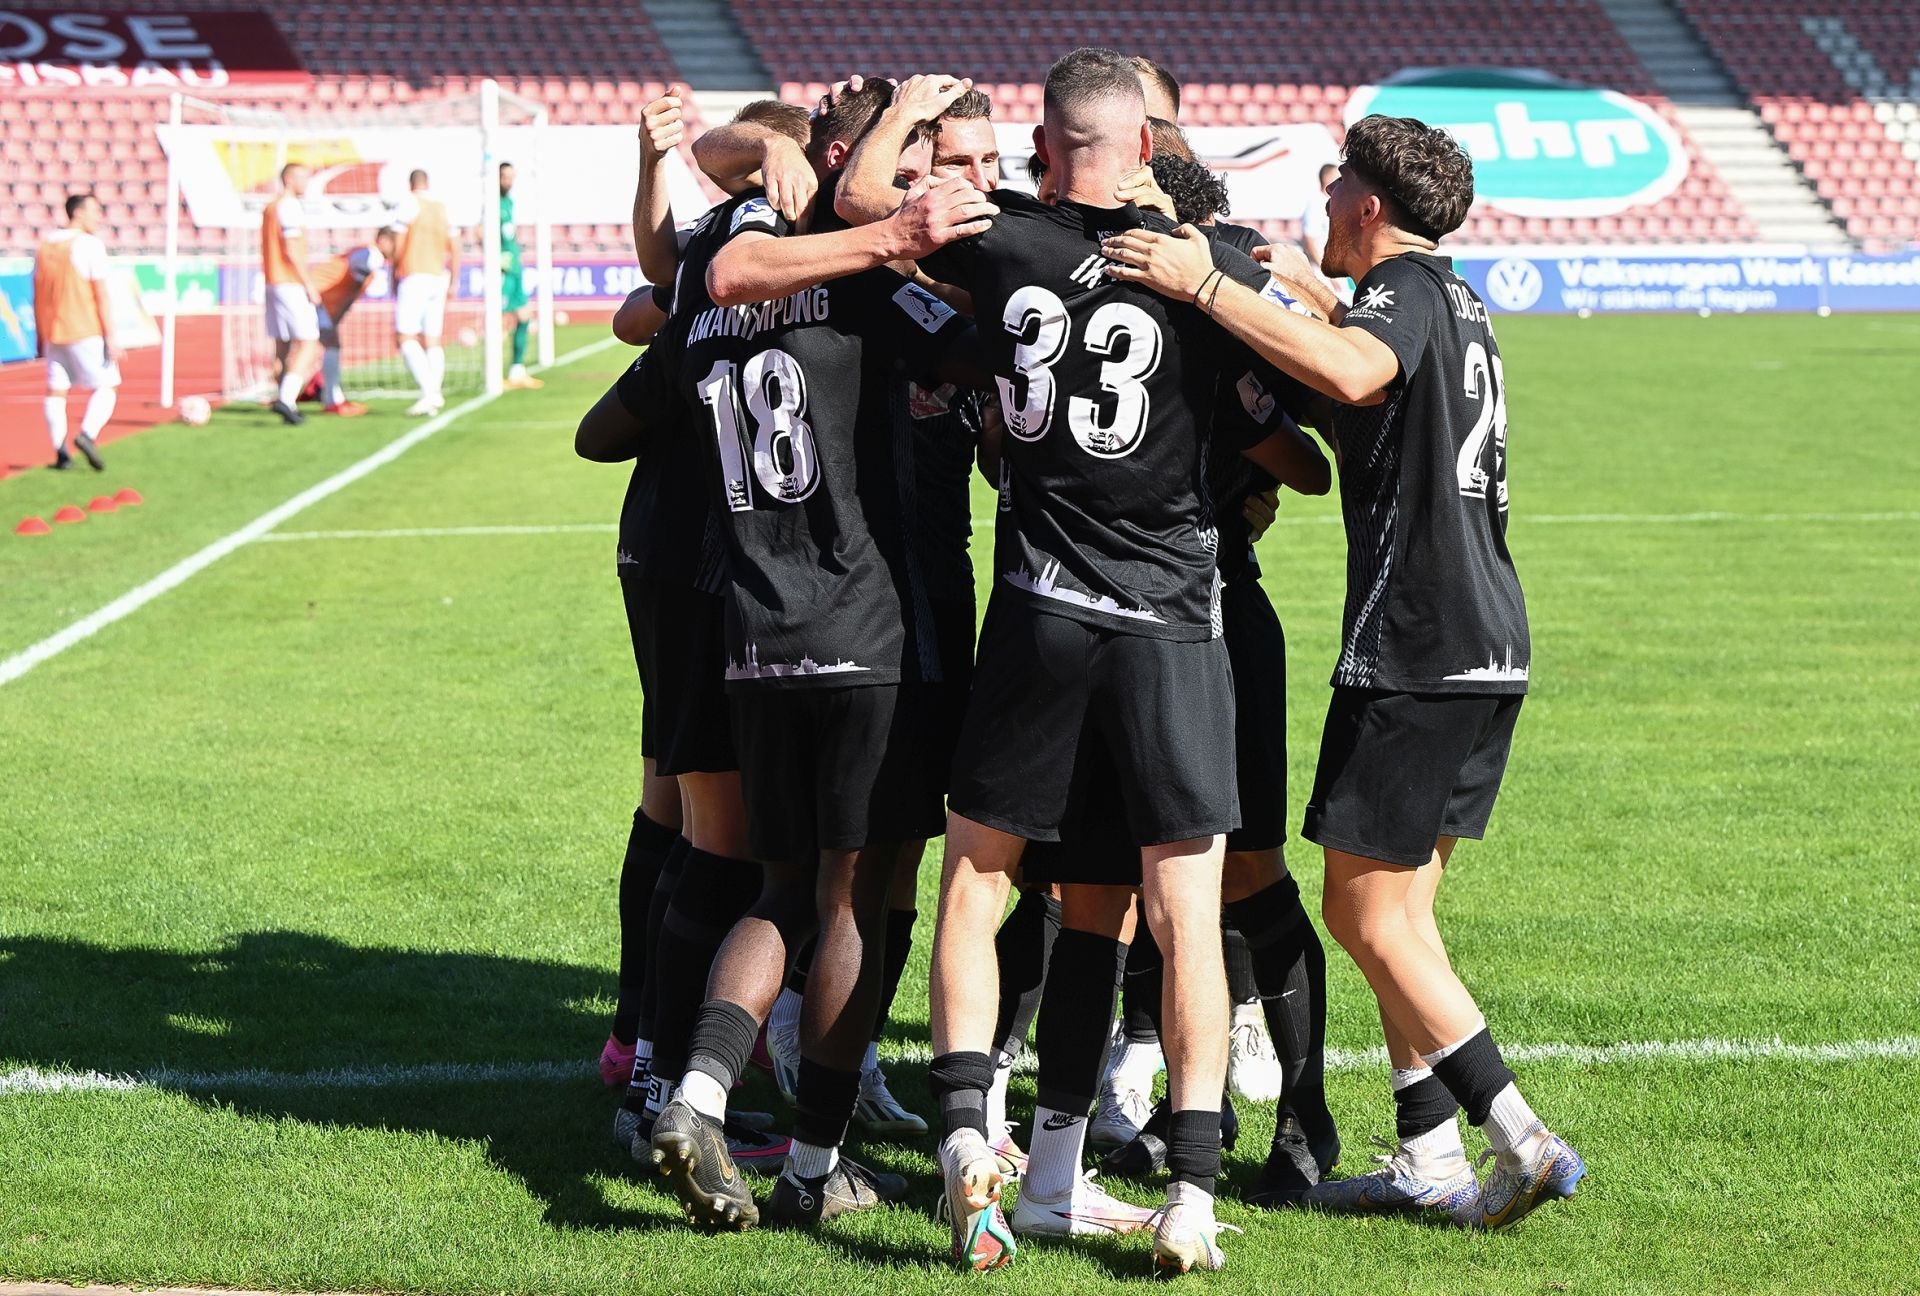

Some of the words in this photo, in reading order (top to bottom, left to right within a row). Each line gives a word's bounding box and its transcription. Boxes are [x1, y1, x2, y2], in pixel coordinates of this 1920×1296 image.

[1557, 258, 1741, 290] Volkswagen
[1741, 256, 1822, 286] Werk
[1560, 288, 1599, 309] Wir
[1600, 287, 1673, 309] stärken
[1674, 285, 1705, 308] die
[1707, 287, 1778, 313] Region
[994, 285, 1163, 460] 33
[696, 348, 821, 513] 18
[1050, 1112, 1077, 1126] NIKE
